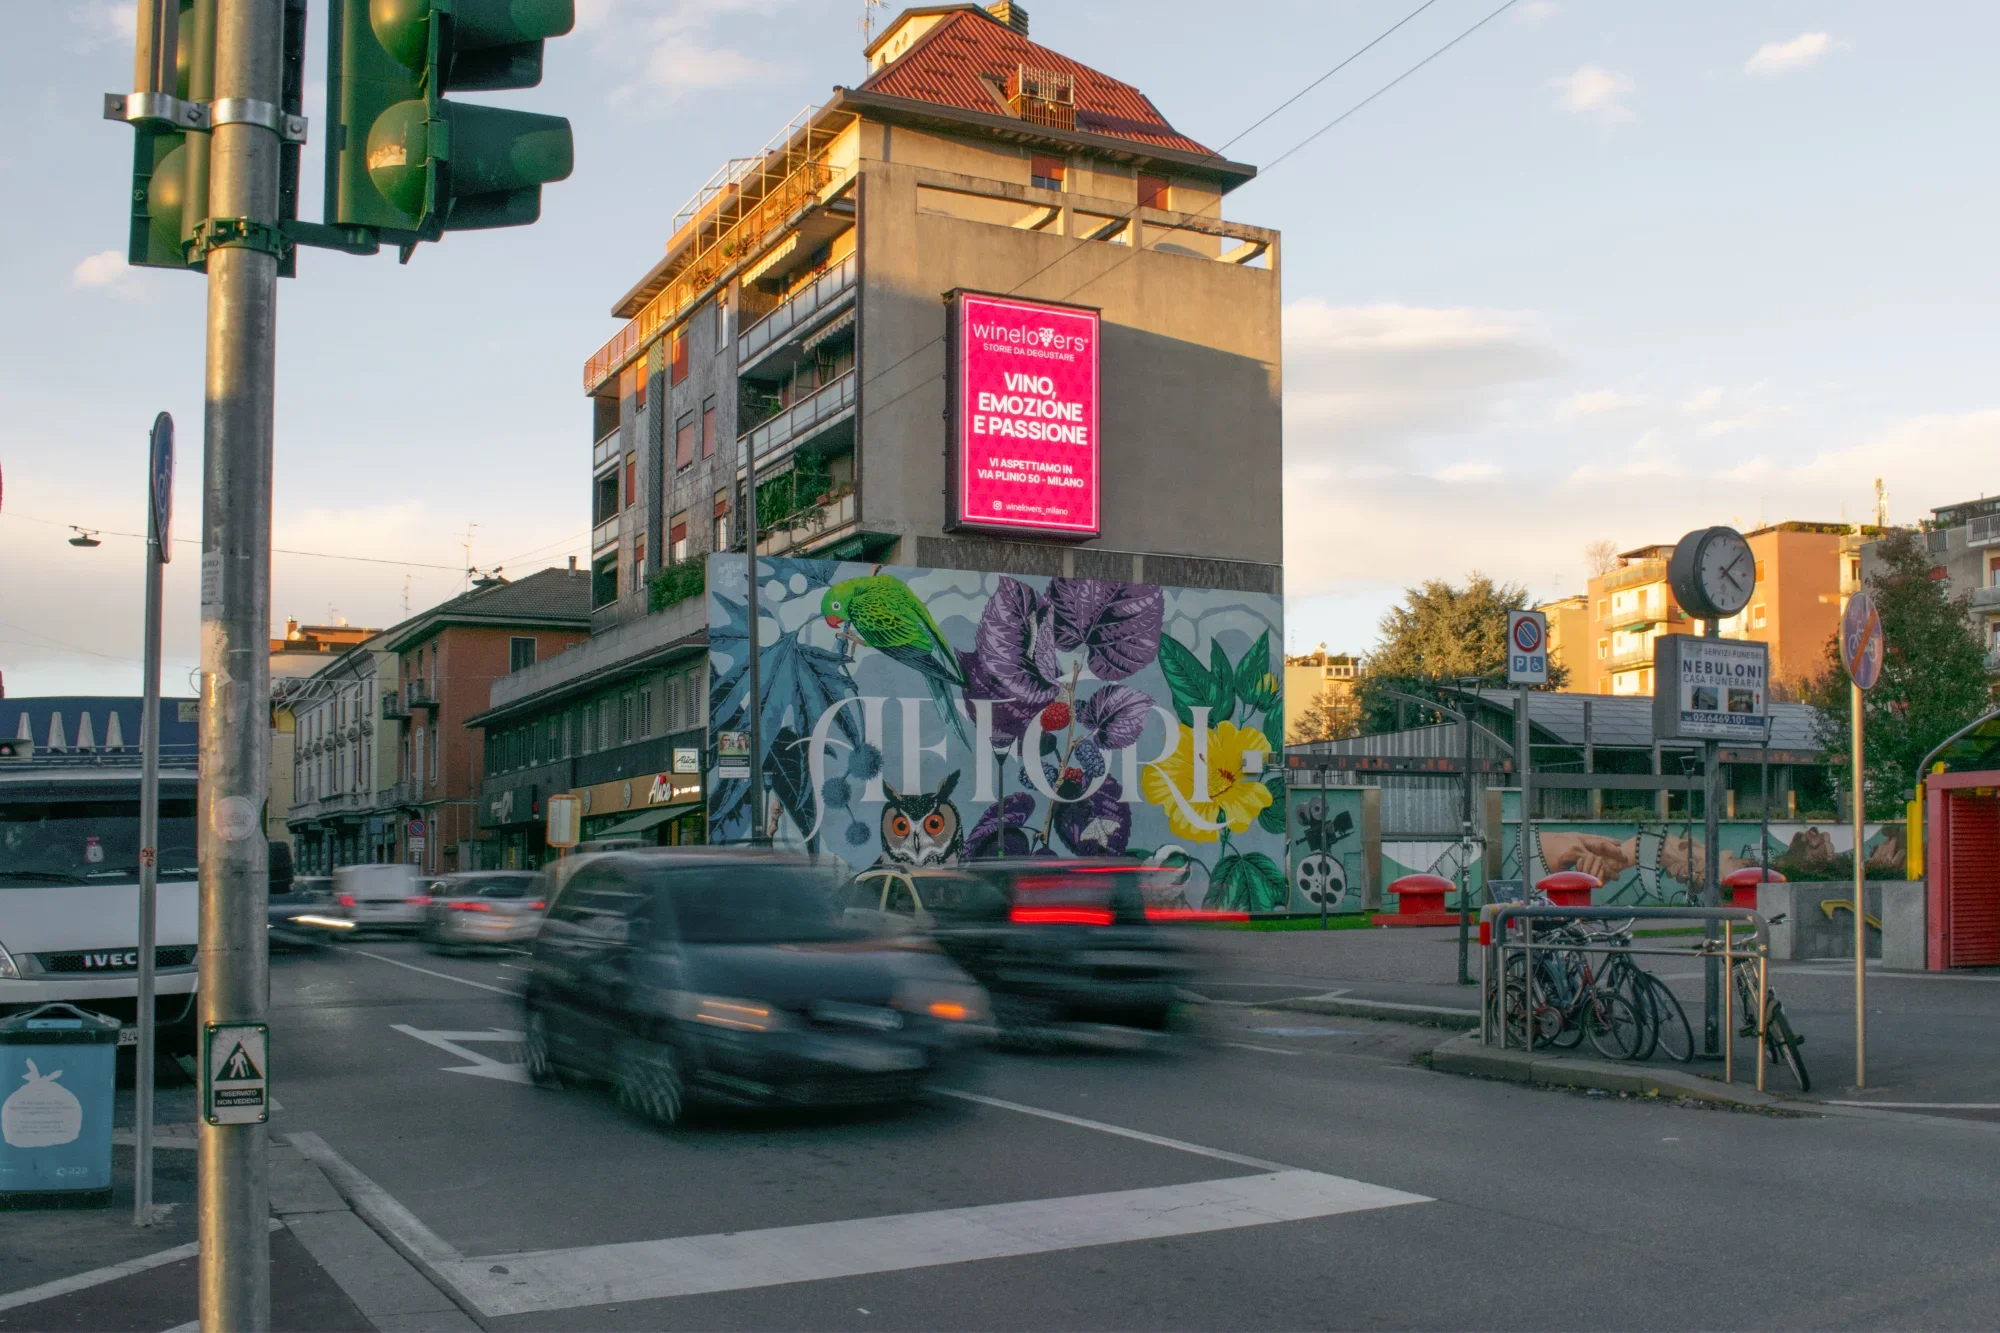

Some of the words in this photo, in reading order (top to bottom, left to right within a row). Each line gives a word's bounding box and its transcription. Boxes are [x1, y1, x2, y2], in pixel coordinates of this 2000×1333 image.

[983, 343, 1012, 354] STORIE
[1014, 347, 1025, 356] DA
[1027, 348, 1074, 362] DEGUSTARE
[1004, 371, 1056, 400] VINO,
[978, 391, 1083, 422] EMOZIONE
[974, 414, 986, 434] E
[989, 416, 1087, 446] PASSIONE
[989, 457, 999, 467] VI
[1000, 458, 1061, 473] ASPETTIAMO
[1062, 464, 1072, 474] IN
[978, 468, 994, 479] VIA
[995, 470, 1026, 482] PLINIO
[1028, 474, 1040, 484] 50
[1047, 475, 1084, 488] MILANO
[1704, 648, 1731, 657] SERVIZI
[1516, 657, 1525, 670] P
[1683, 660, 1762, 679] NEBULONI
[1683, 673, 1706, 684] CASA
[1709, 675, 1761, 688] FUNERARIA
[84, 953, 137, 967] IVEC
